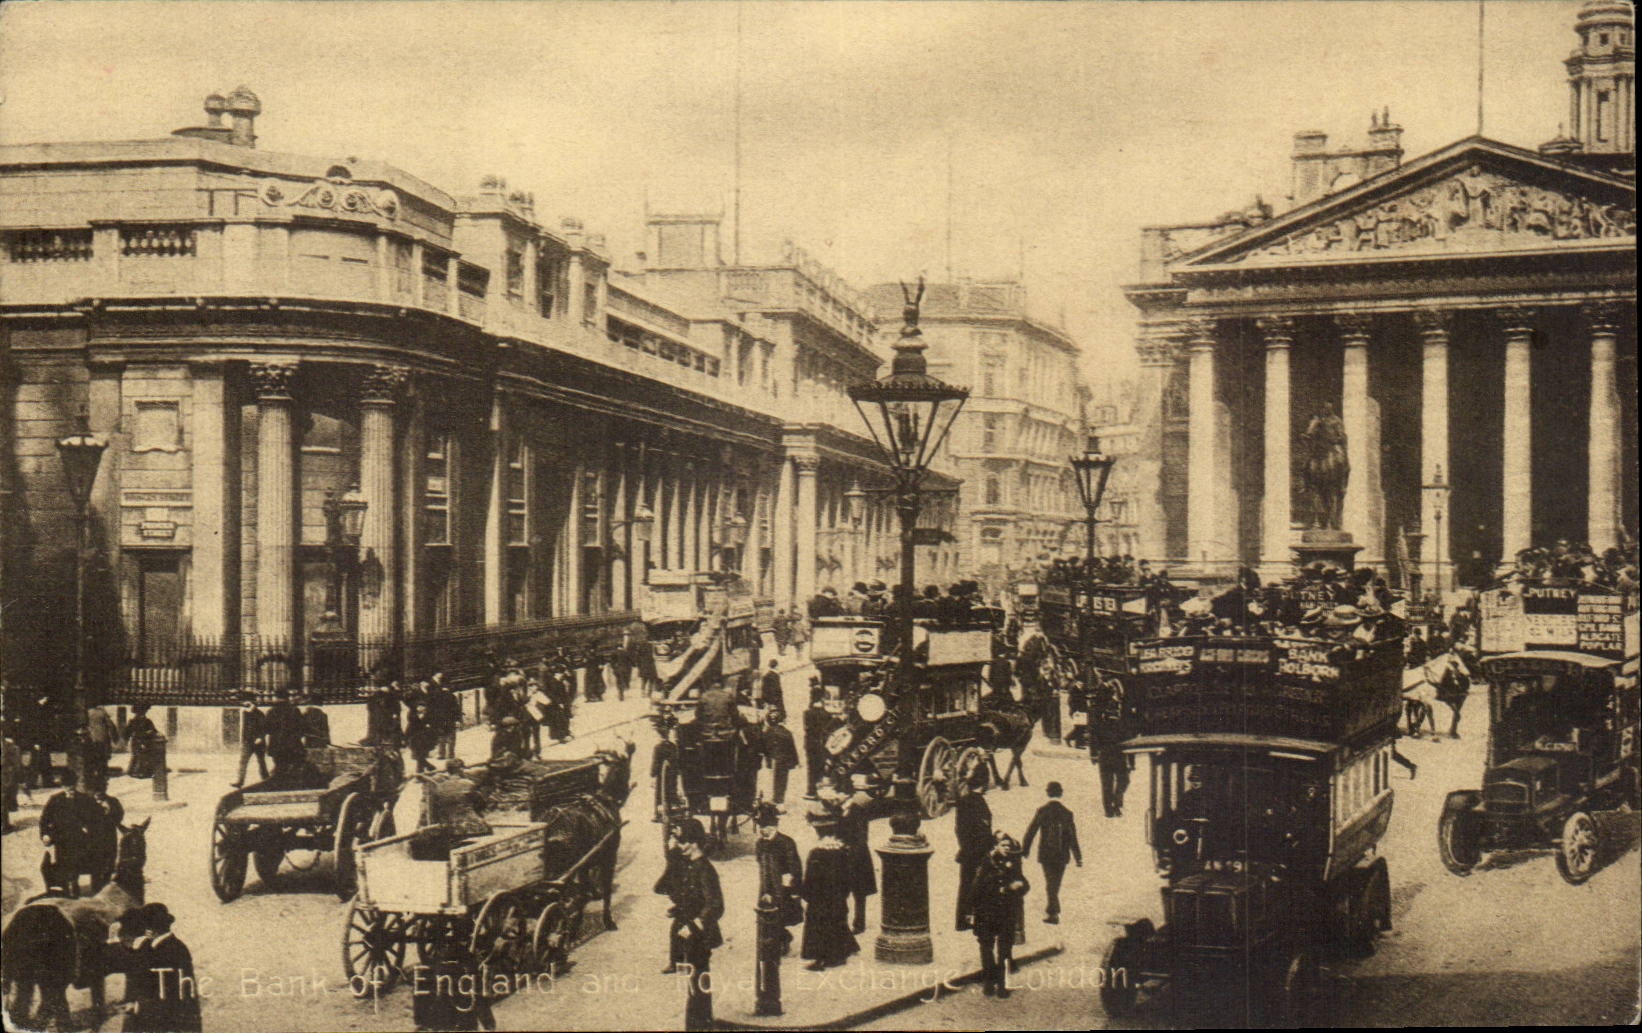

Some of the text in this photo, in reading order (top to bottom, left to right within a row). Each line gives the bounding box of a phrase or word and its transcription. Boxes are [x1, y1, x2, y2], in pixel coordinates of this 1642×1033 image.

[1528, 586, 1577, 600] PUTNEY
[1580, 641, 1623, 651] POPLAR
[1287, 648, 1329, 664] BANK
[1279, 660, 1340, 680] HOLBORN
[836, 725, 885, 776] OXFORD
